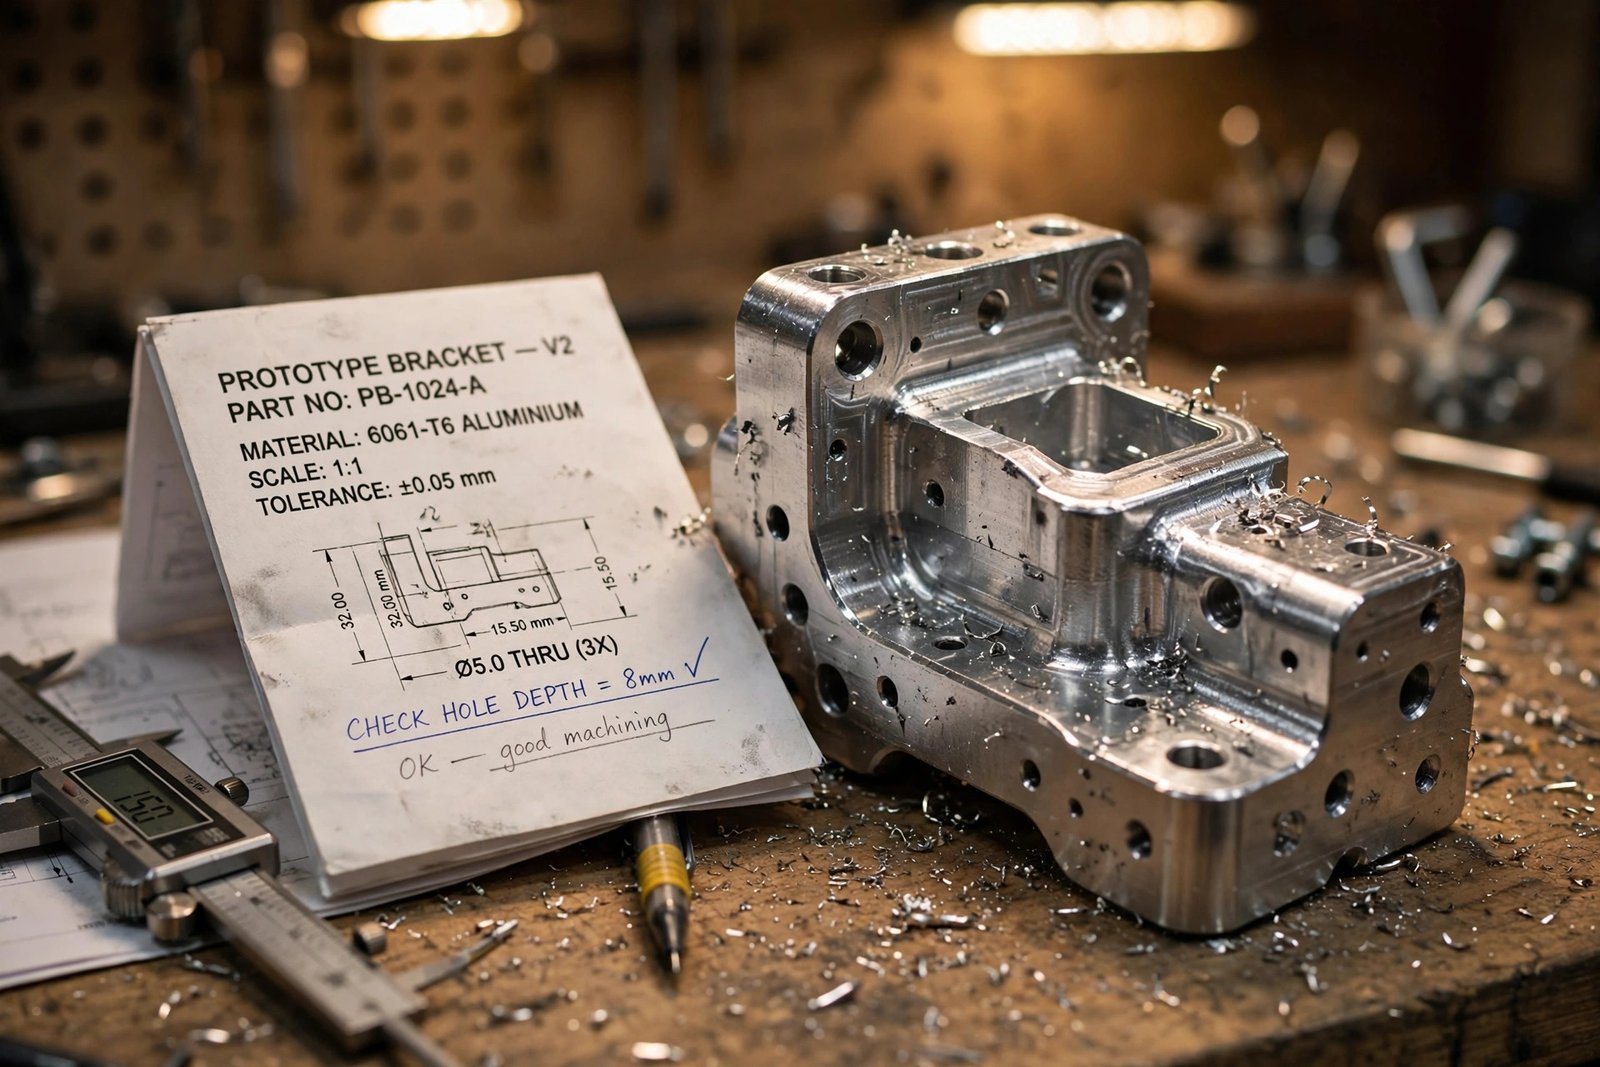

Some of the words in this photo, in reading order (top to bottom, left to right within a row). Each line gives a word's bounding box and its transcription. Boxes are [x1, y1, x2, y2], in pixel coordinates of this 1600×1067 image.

[218, 355, 382, 393] PROTOTYPE
[388, 342, 506, 373] BRACKET
[542, 336, 575, 355] V2
[227, 396, 295, 423] PART
[304, 390, 352, 414] NO:
[358, 375, 487, 407] PB-1024-A
[240, 430, 362, 462] MATERIAL:
[368, 417, 455, 444] 6061-T6
[462, 401, 584, 433] ALUMINIUM
[248, 463, 326, 489] SCALE:
[333, 458, 363, 477] 1:1
[256, 482, 392, 516] TOLERANCE:
[399, 472, 454, 496] ±0.05
[461, 469, 497, 487] mm
[374, 569, 391, 591] mm
[594, 556, 617, 592] 15.50
[331, 592, 354, 630] 32.00
[490, 619, 527, 635] 15.50
[532, 617, 554, 630] mm
[455, 654, 505, 679] Ø5.0
[509, 642, 570, 668] THRU
[576, 634, 619, 662] (3X)
[346, 710, 430, 741] CHECK
[443, 695, 500, 724] HOLE
[512, 679, 587, 710] DEPTH
[623, 667, 675, 690] 8mm
[399, 754, 439, 781] OK
[499, 727, 551, 773] good
[563, 711, 672, 746] machining
